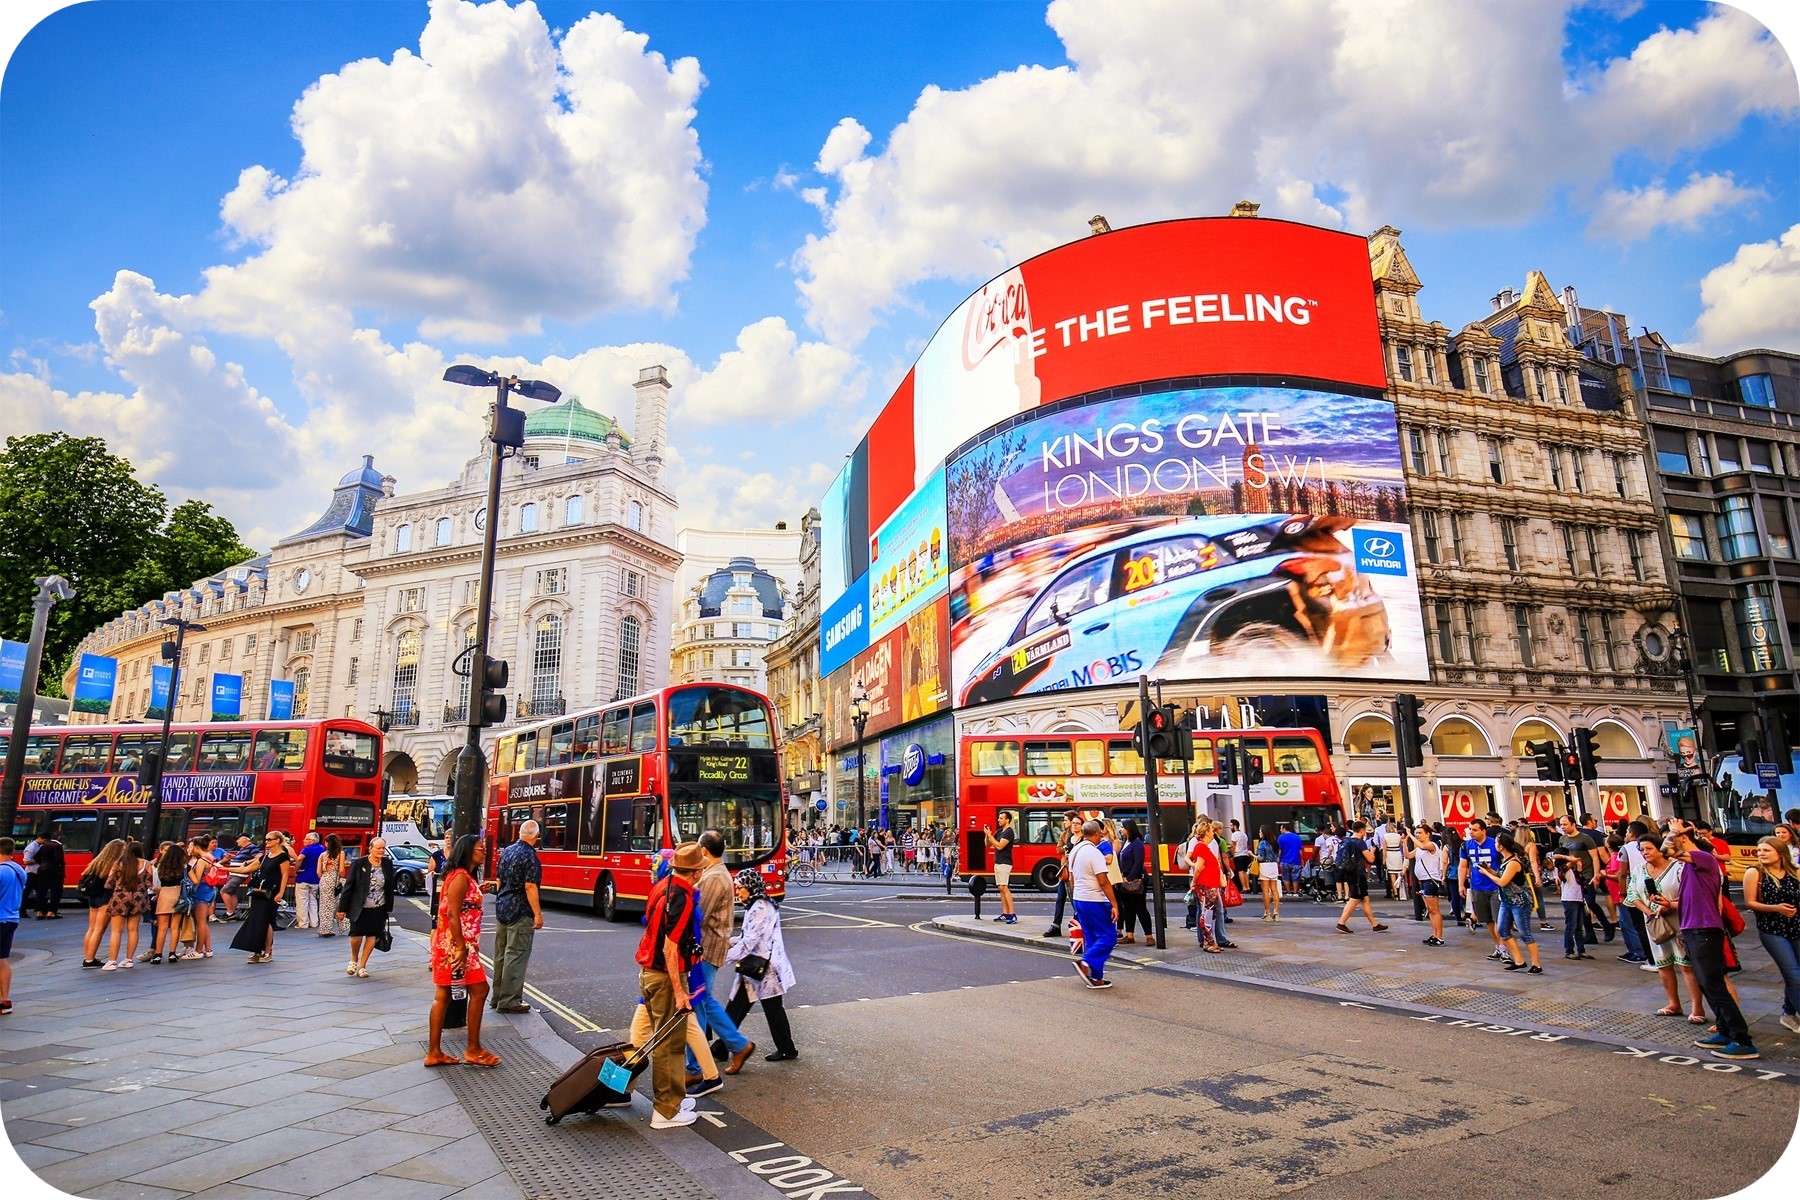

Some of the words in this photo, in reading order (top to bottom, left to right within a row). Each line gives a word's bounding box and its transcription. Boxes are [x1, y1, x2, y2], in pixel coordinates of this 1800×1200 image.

[1055, 304, 1131, 347] THE
[1042, 418, 1164, 473] KINGS
[1176, 412, 1284, 449] GATE
[1044, 454, 1229, 512] LONDON
[1247, 453, 1327, 491] SW1
[1123, 556, 1155, 591] 20
[1361, 557, 1402, 570] HYUNDAI
[826, 602, 863, 652] SAMSUNG
[1026, 632, 1071, 663] VÄRMLAND
[1071, 649, 1143, 687] MOBIS
[699, 770, 727, 781] Piccadilly
[729, 770, 748, 779] Circus
[734, 756, 747, 769] 22
[176, 788, 194, 802] THE
[198, 787, 225, 801] WEST
[190, 775, 250, 788] TRIUMPHANTLY
[611, 776, 625, 785] JULY
[626, 775, 633, 784] 27
[1080, 783, 1111, 791] Fresher.
[25, 791, 46, 804] WISH
[1100, 791, 1132, 800] Hotpoint
[1441, 790, 1475, 819] 70
[1522, 790, 1554, 819] 70
[1599, 790, 1629, 817] 70
[1409, 1014, 1571, 1043] RIGHT
[1612, 1046, 1787, 1081] LOOK
[727, 1142, 864, 1200] LOOK
